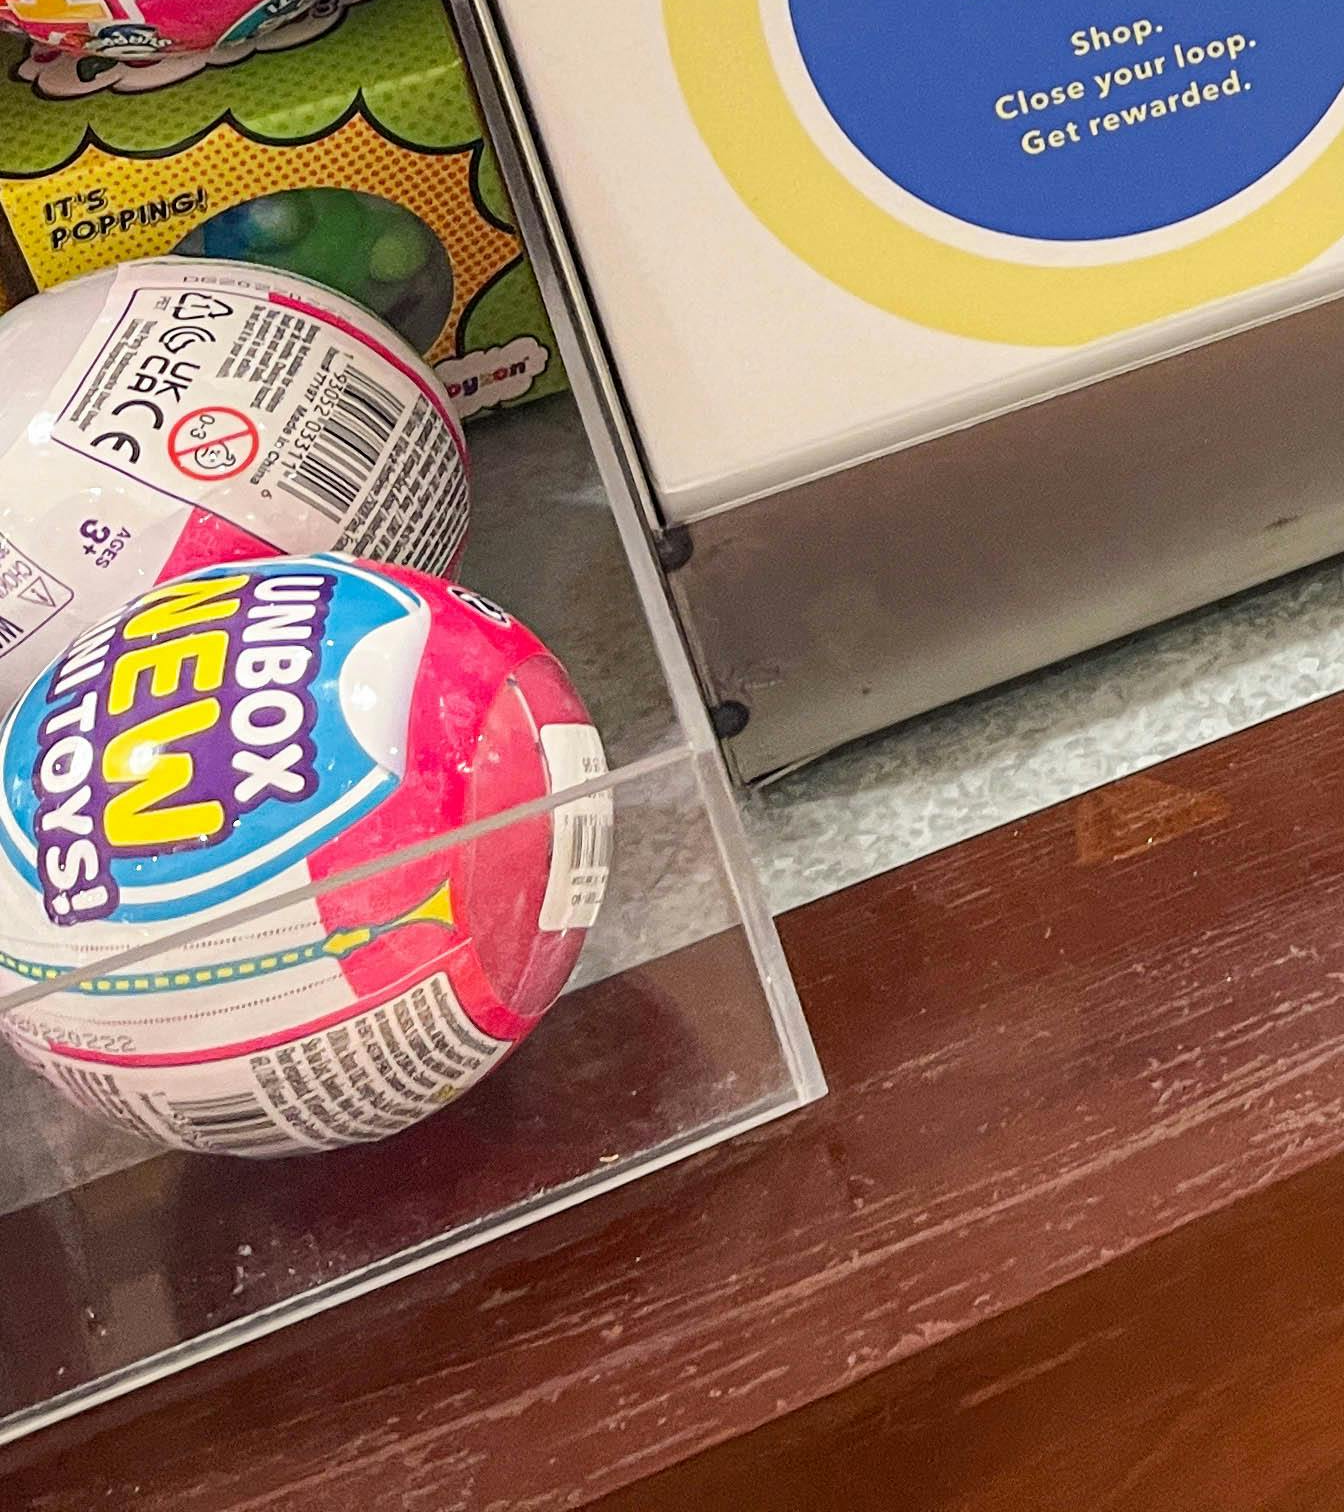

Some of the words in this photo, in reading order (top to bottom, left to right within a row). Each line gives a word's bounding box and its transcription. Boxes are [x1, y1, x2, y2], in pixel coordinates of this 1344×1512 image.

[1069, 18, 1163, 56] Shop.
[994, 80, 1085, 120] Close
[1093, 55, 1165, 99] your
[1173, 33, 1256, 68] loop.
[1020, 120, 1081, 155] Get
[1088, 68, 1251, 136] rewarded.
[44, 188, 108, 223] IT'S
[51, 185, 208, 250] POPPING!
[79, 518, 112, 557] 3+
[95, 525, 132, 570] AGES
[102, 574, 250, 847] NEW
[231, 576, 326, 803] UNBOX
[40, 691, 109, 915] TOYS!
